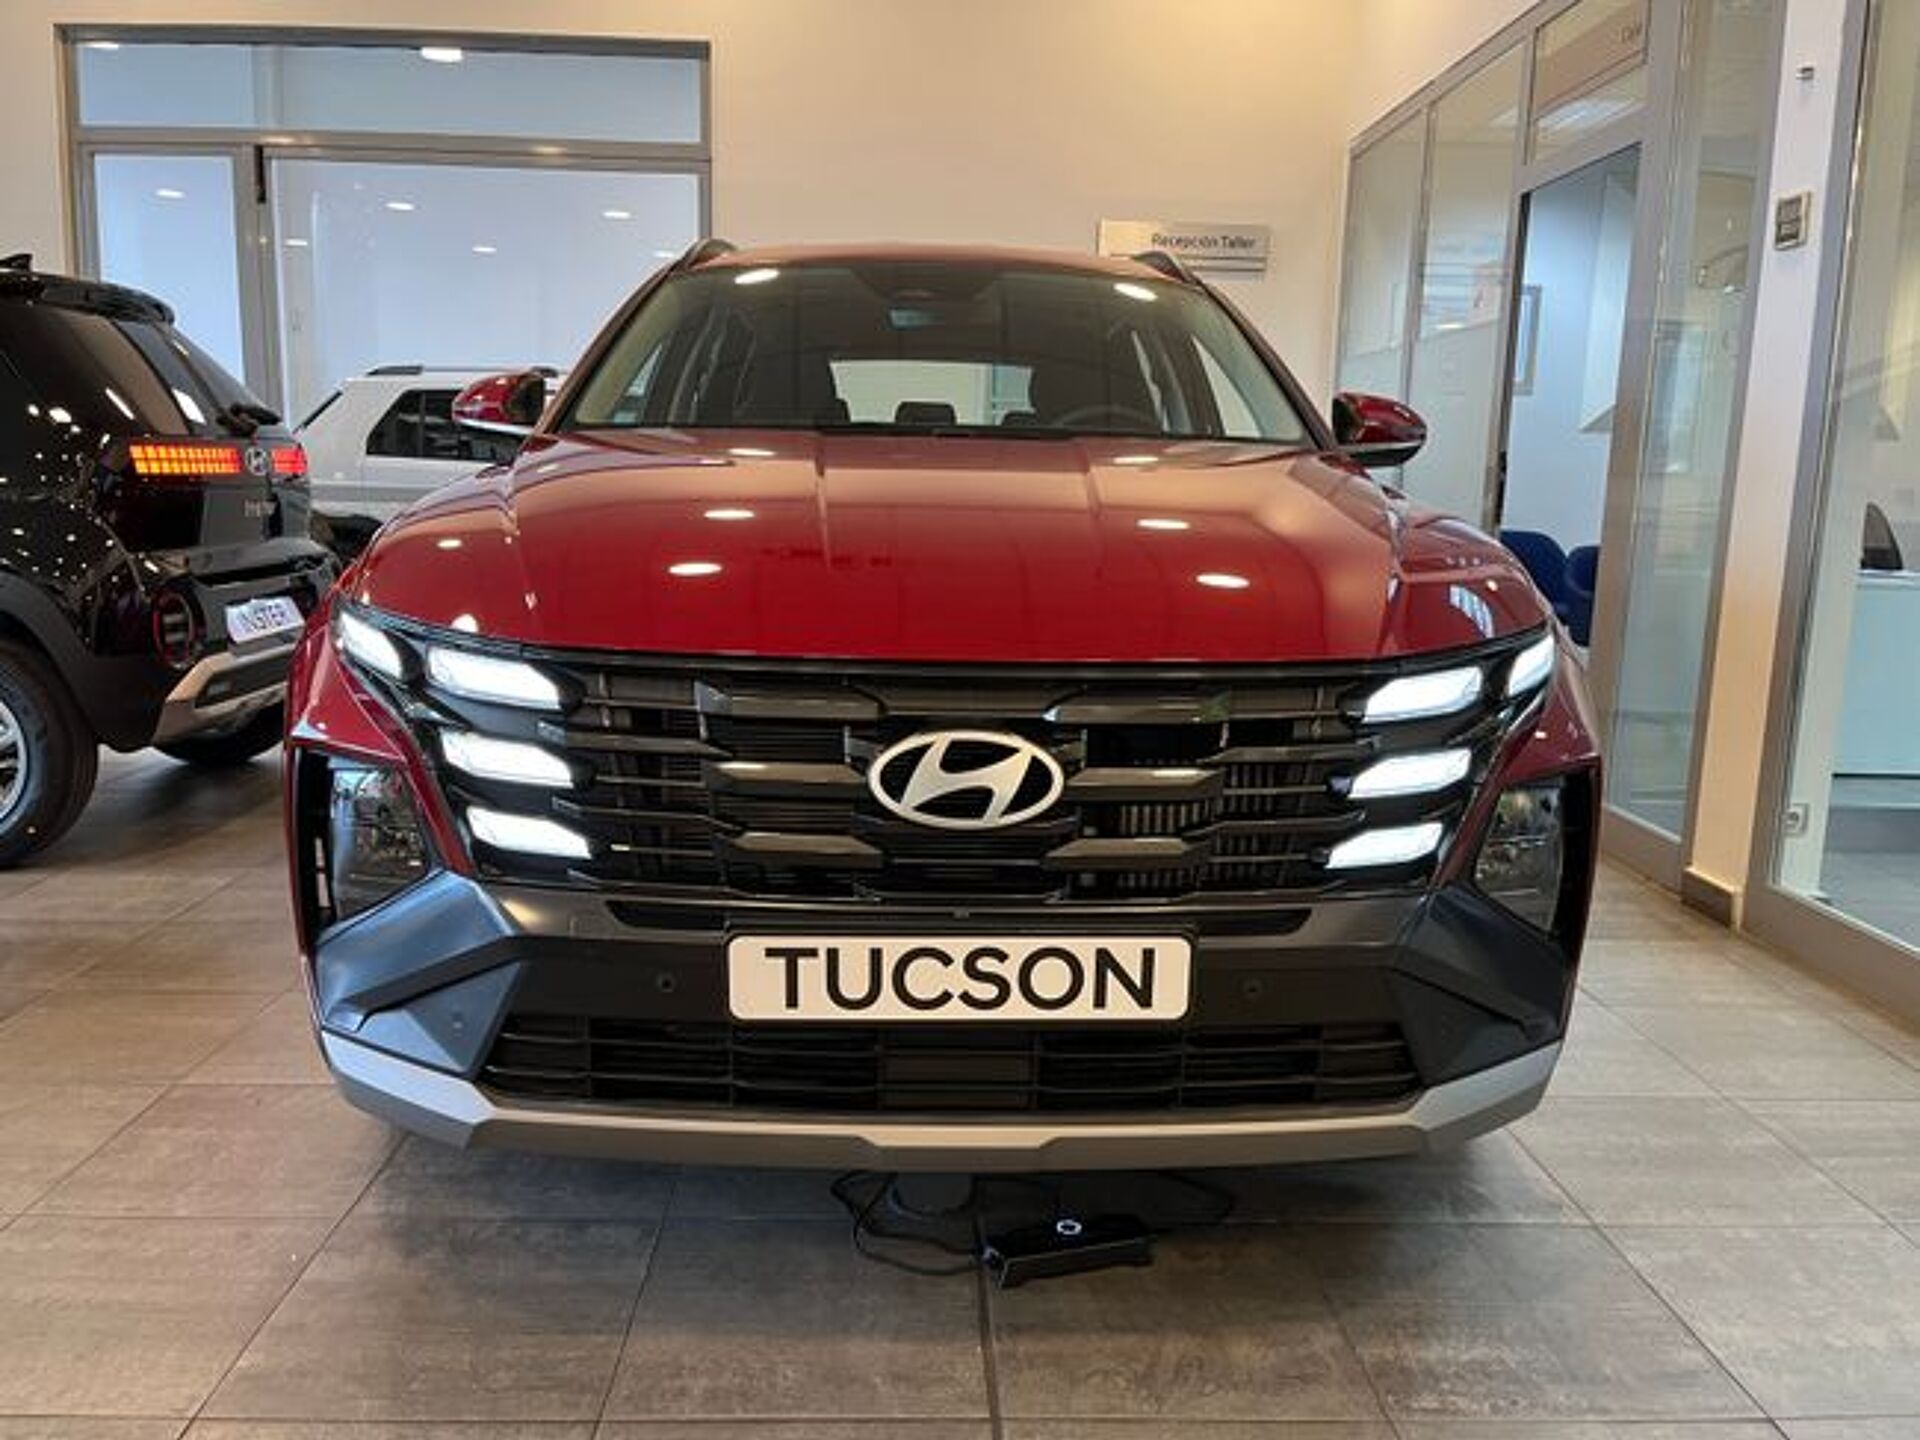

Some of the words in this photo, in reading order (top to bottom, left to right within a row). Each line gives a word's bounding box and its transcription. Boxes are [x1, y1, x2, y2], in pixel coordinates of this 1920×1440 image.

[1152, 233, 1218, 249] Recepción
[1221, 235, 1256, 248] Taller
[764, 946, 1155, 1010] TUCSON
